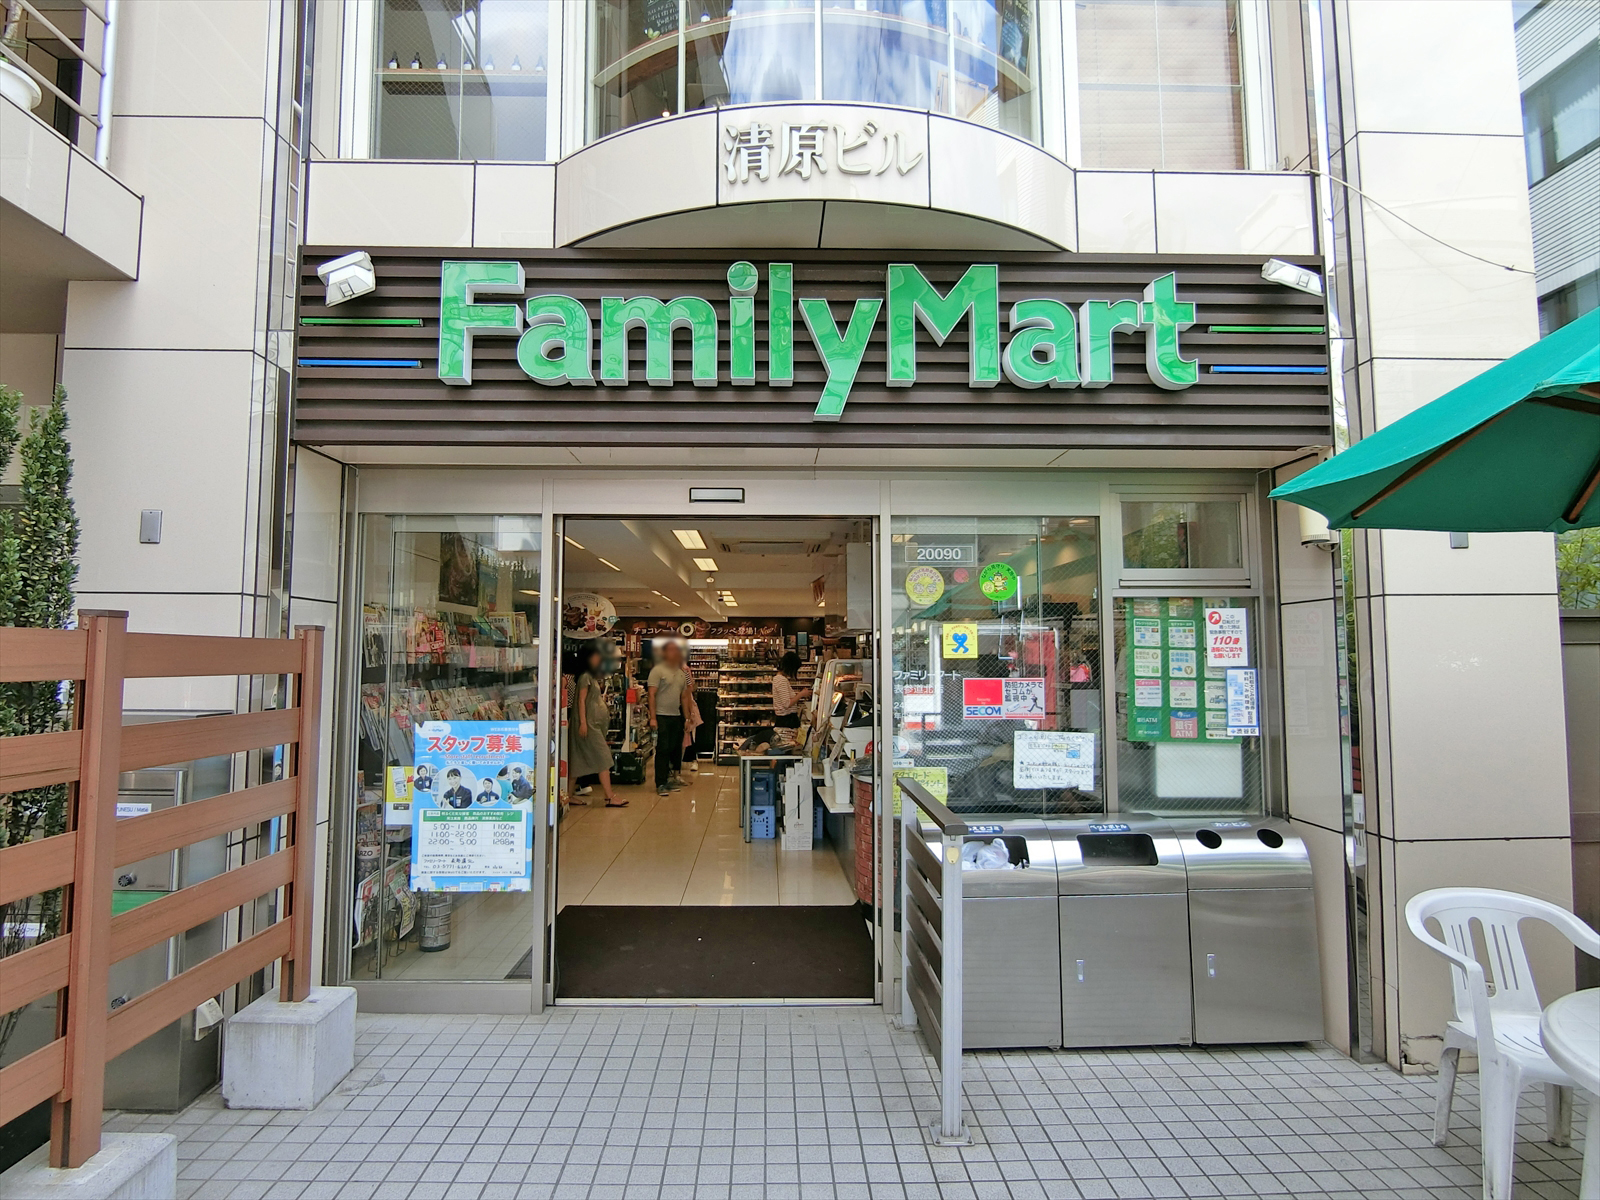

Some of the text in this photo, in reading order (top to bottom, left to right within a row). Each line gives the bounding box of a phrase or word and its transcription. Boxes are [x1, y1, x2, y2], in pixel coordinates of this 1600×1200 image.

[724, 121, 924, 184] 清原ビル
[437, 261, 1201, 422] FamilyMart
[917, 548, 961, 560] 20090
[1213, 636, 1240, 645] 110番
[966, 706, 1002, 716] SECOM
[427, 735, 523, 753] スタッフ募集
